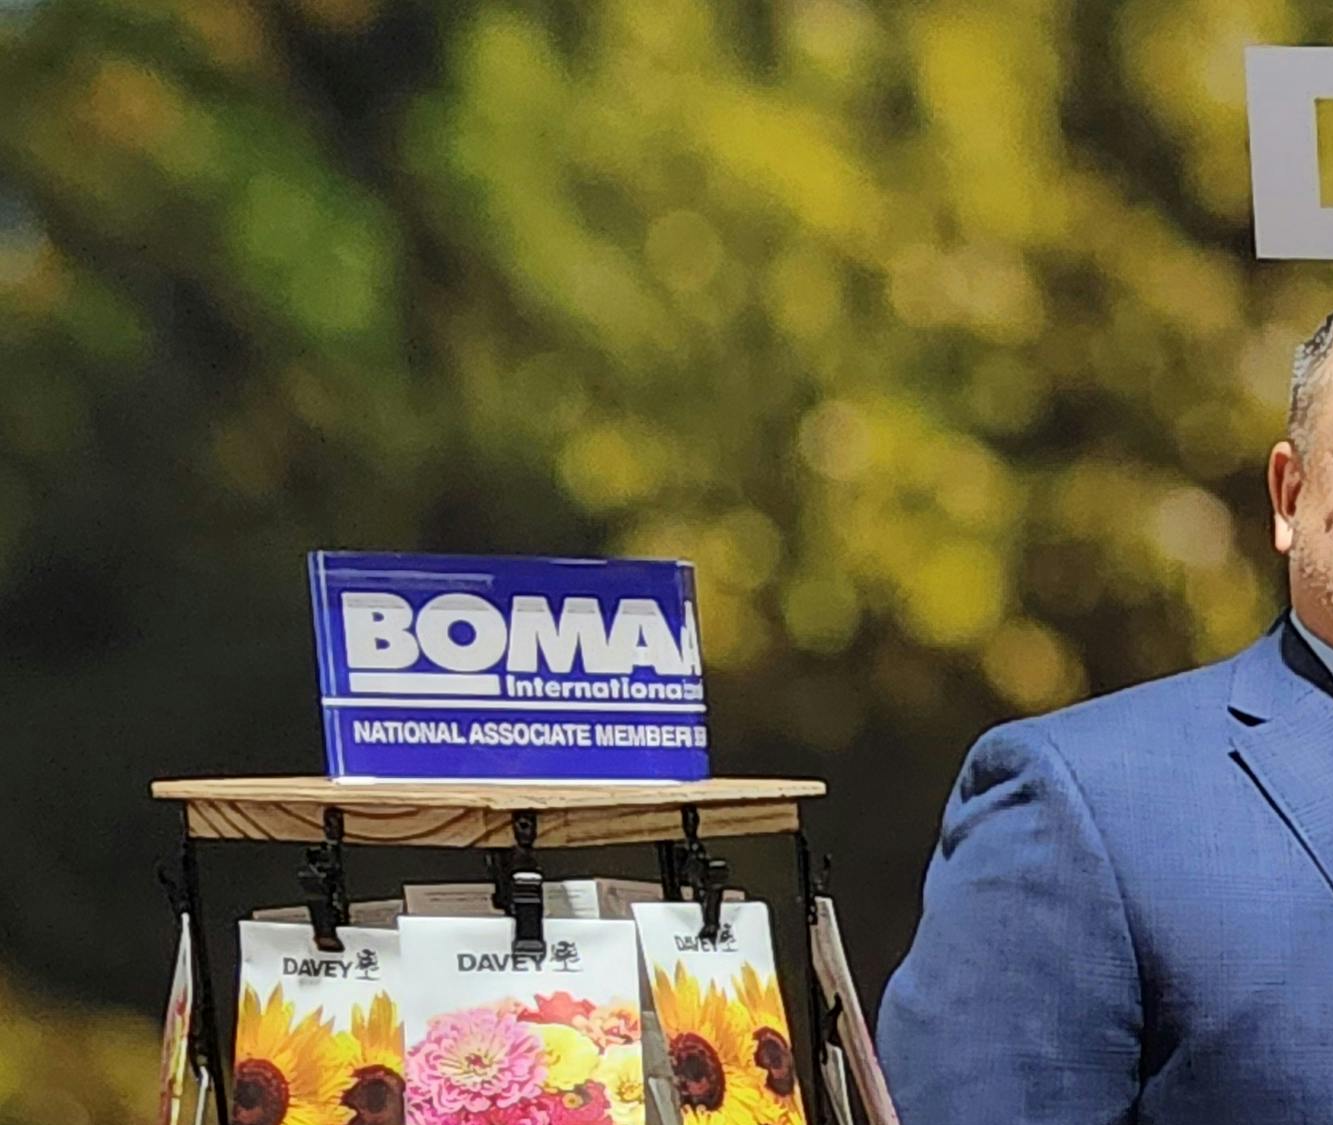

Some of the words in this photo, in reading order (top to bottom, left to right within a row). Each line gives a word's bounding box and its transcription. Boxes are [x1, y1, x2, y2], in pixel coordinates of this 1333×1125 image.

[340, 591, 692, 676] BOMA
[353, 720, 466, 745] NATIONAL
[469, 721, 592, 746] ASSOCIATE
[595, 723, 695, 748] MEMBER
[282, 956, 354, 979] DAVEY
[457, 953, 545, 973] DAVEY
